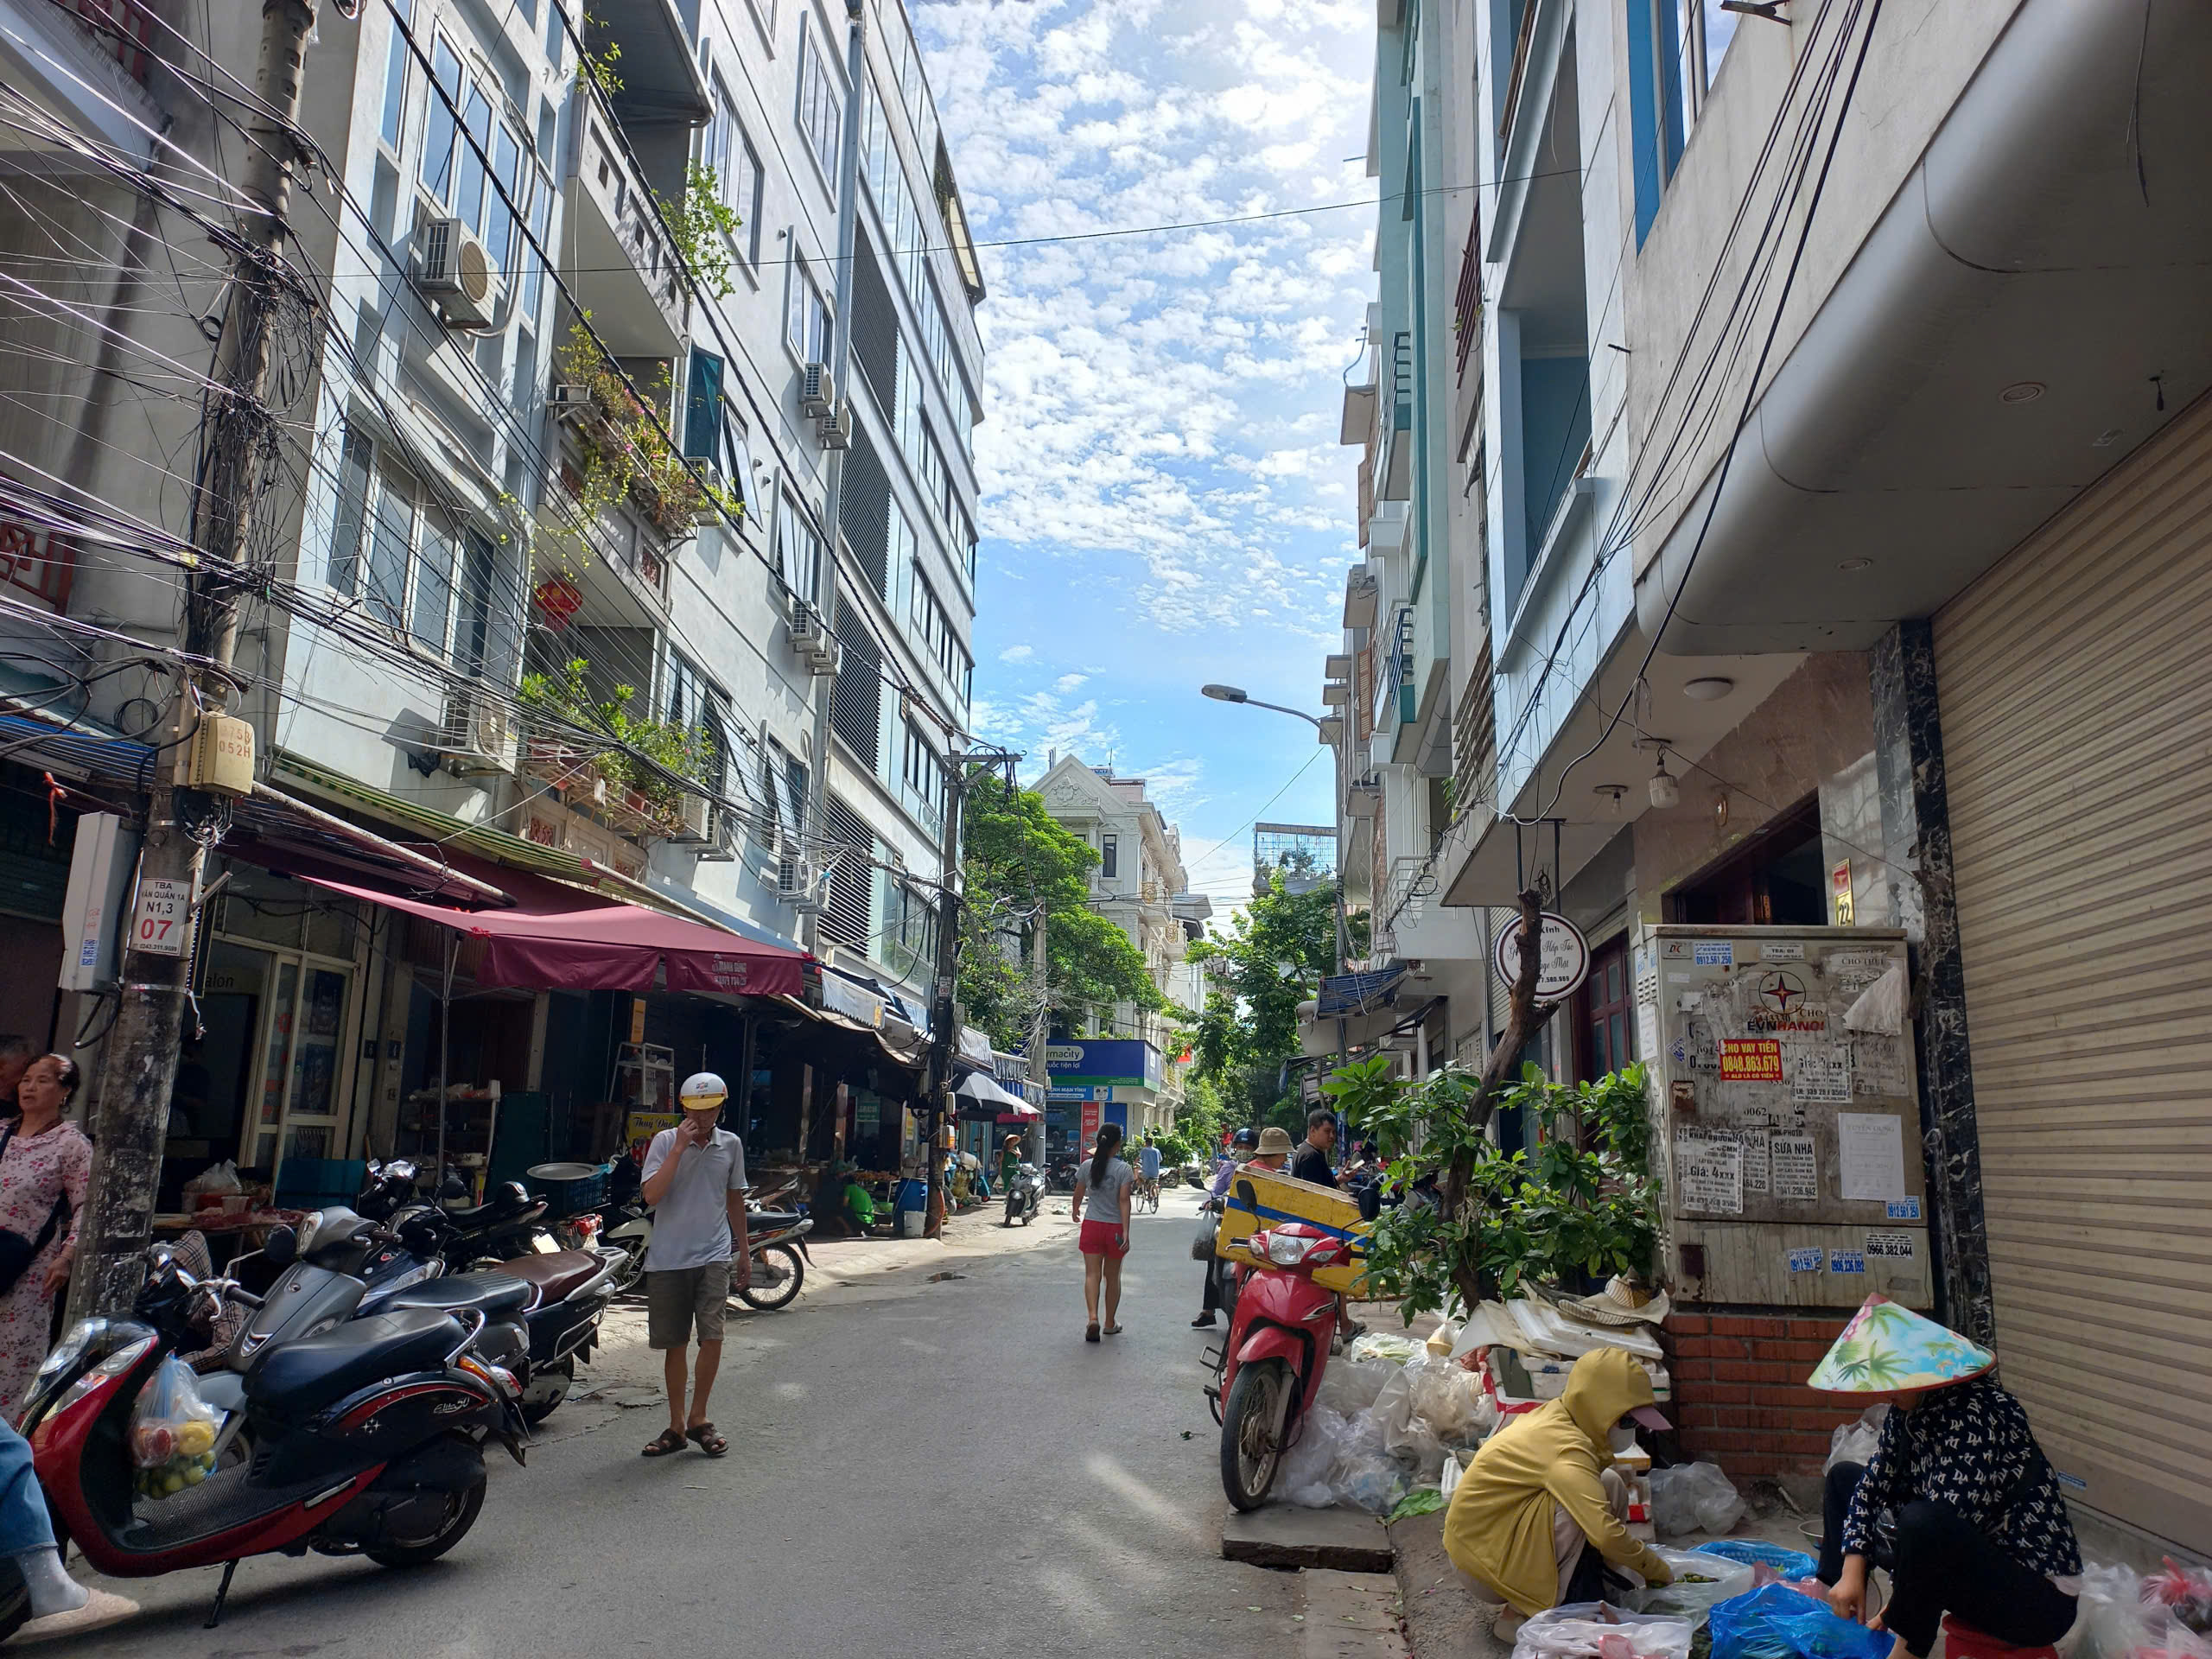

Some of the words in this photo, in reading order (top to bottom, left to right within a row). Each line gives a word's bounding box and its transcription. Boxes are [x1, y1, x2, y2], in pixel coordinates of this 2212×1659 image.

[219, 741, 251, 759] 052H
[155, 881, 172, 890] TBA
[146, 901, 174, 915] N1,3
[140, 918, 174, 940] 07
[204, 973, 234, 988] alon
[1046, 1046, 1080, 1059] rmacity
[1741, 1043, 1756, 1053] VAY
[1722, 1055, 1780, 1072] 0848.863.679
